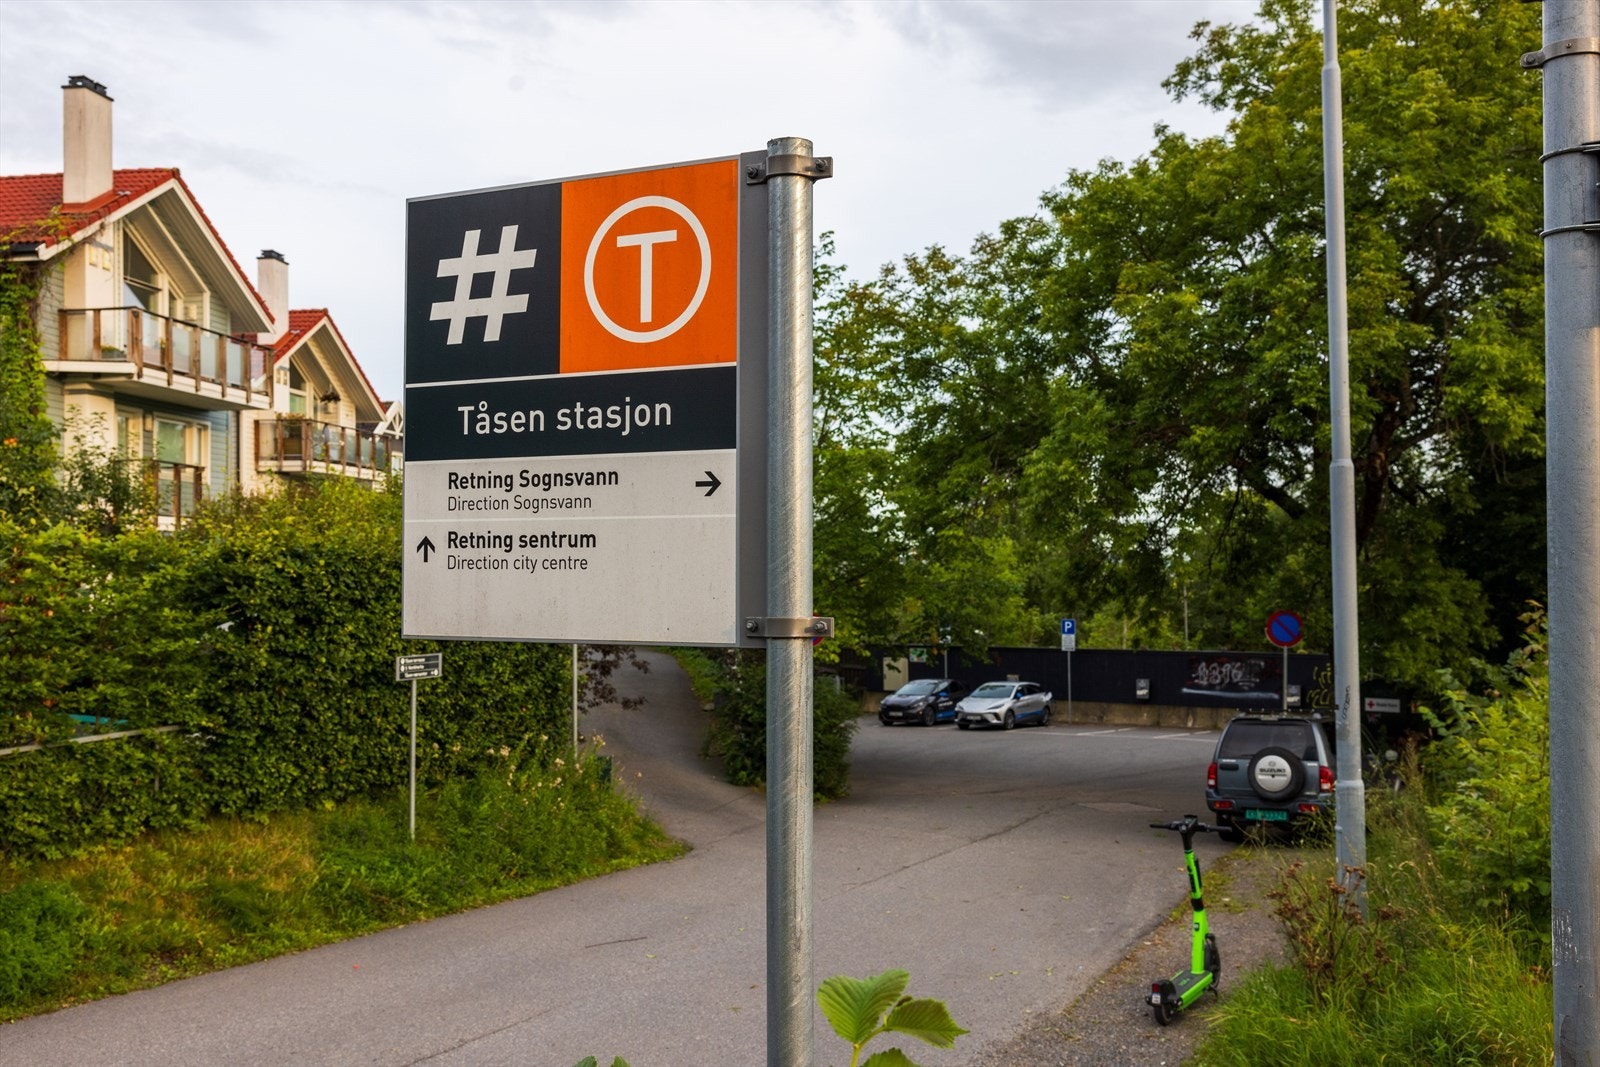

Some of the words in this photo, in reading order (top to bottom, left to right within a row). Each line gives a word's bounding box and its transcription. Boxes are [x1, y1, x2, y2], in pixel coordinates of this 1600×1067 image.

[458, 401, 545, 435] Tåsen
[556, 396, 672, 436] stasjon
[448, 471, 514, 492] Retning
[519, 469, 619, 491] Sognsvann
[447, 496, 509, 511] Direction
[513, 494, 592, 513] Sognsvann
[447, 531, 513, 552] Retning
[518, 532, 597, 548] sentrum
[447, 555, 508, 570] Direction
[513, 555, 538, 573] city
[541, 556, 588, 570] centre
[1064, 621, 1073, 633] P
